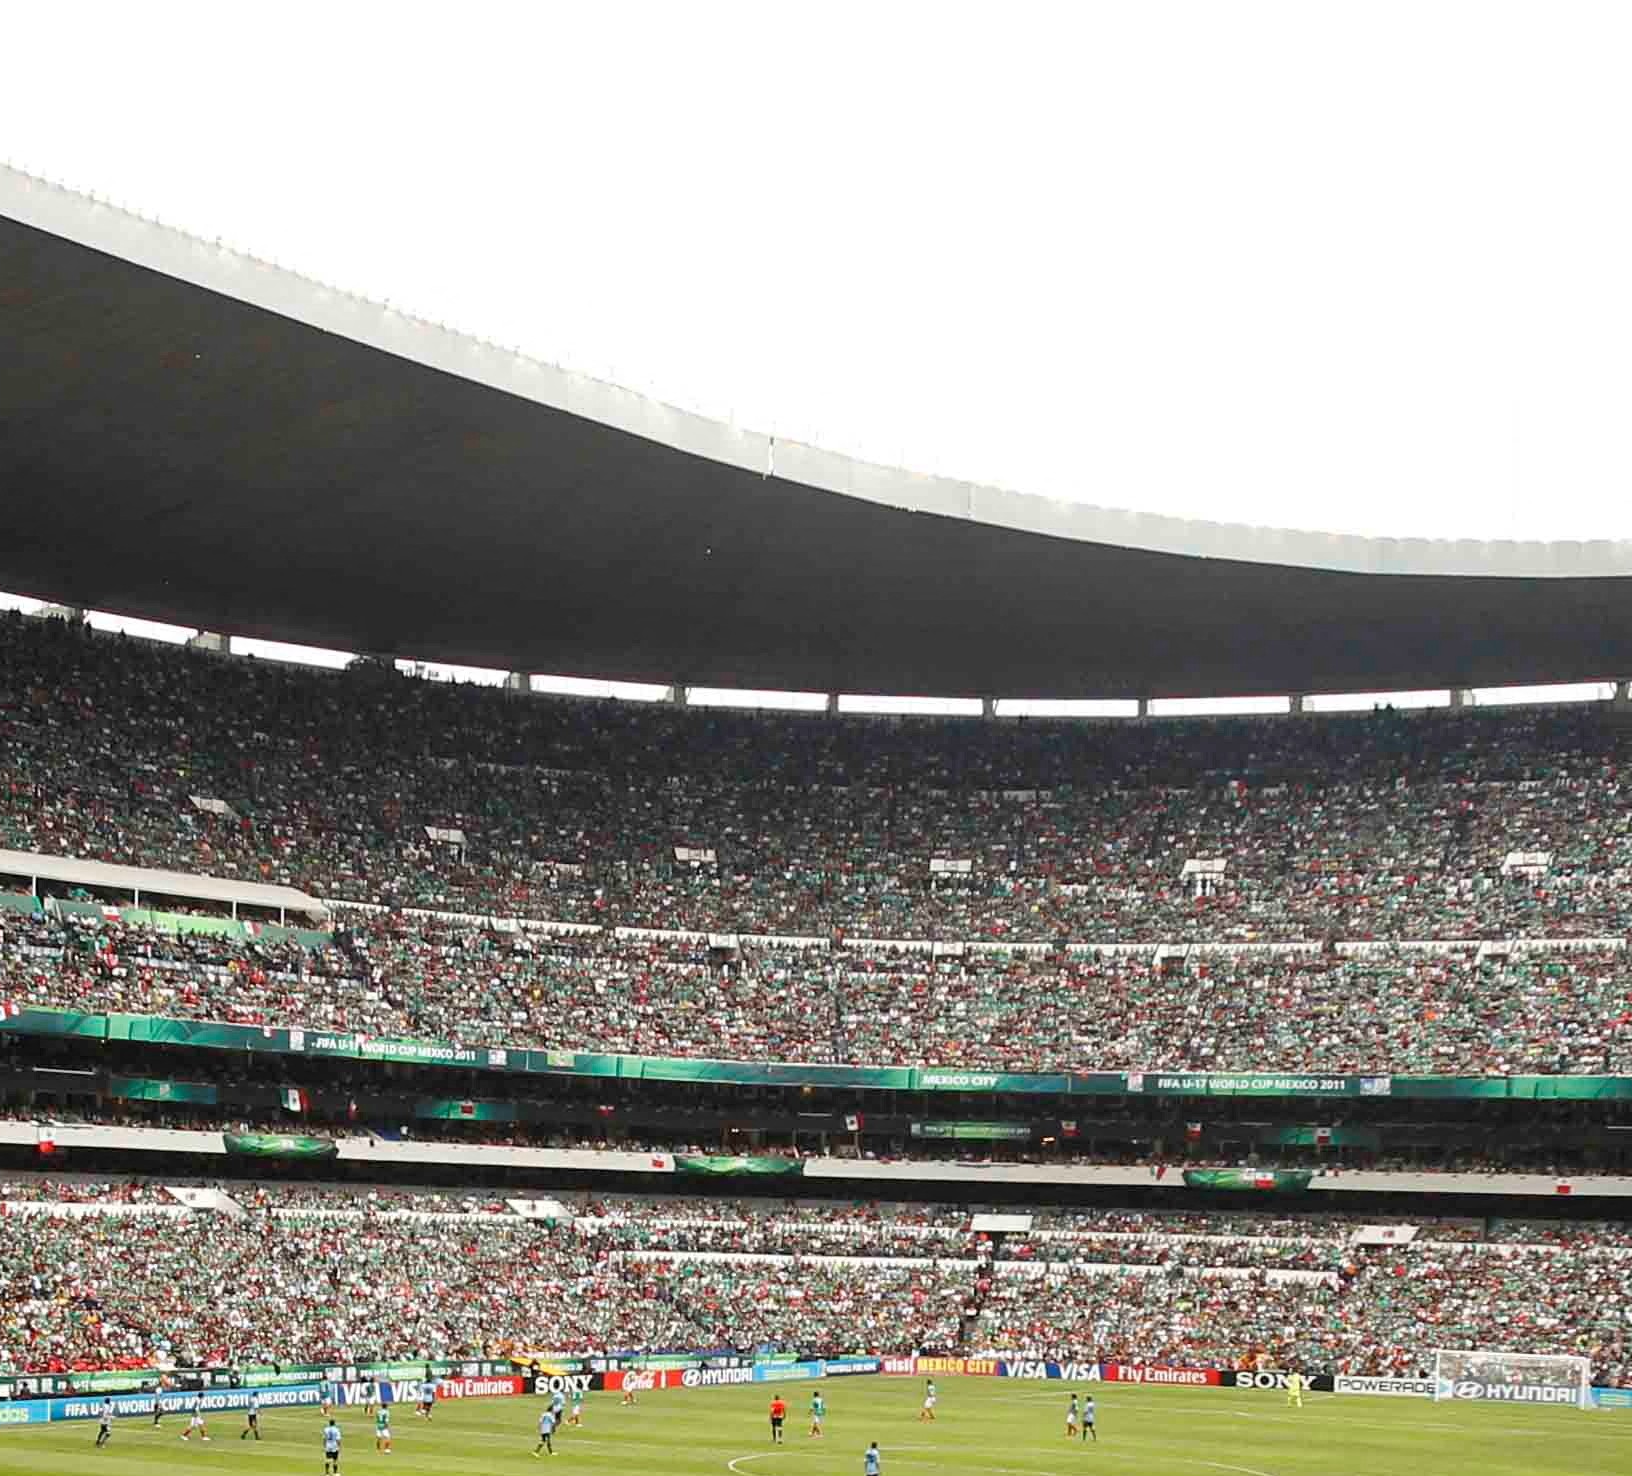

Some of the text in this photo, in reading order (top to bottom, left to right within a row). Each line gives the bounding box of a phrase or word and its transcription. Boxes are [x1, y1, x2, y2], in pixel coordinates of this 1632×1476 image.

[362, 1042, 396, 1055] WORLD
[398, 1044, 416, 1056] CUP
[417, 1046, 453, 1059] MEXICO
[454, 1049, 476, 1060] 2011
[923, 1075, 998, 1087] MEXICO CITY
[1158, 1079, 1345, 1090] FIFA U-17 WORLD CUP MEXICO 2011
[918, 1357, 964, 1373] MEXICO
[968, 1359, 995, 1374] CITY
[1006, 1361, 1048, 1379] VISA
[1059, 1363, 1101, 1381] VISA
[702, 1367, 752, 1383] HYUNDAI
[1118, 1366, 1207, 1384] Fly Emirates
[443, 1378, 514, 1397] Fly Emirates
[535, 1375, 593, 1394] SONY
[1338, 1379, 1436, 1394] POWERADE
[1487, 1384, 1577, 1402] HYUNDAI
[65, 1403, 88, 1417] FIFA
[161, 1398, 184, 1412] CUP
[226, 1394, 249, 1408] 2011
[257, 1391, 297, 1406] MEXICO
[299, 1389, 320, 1403] CITY
